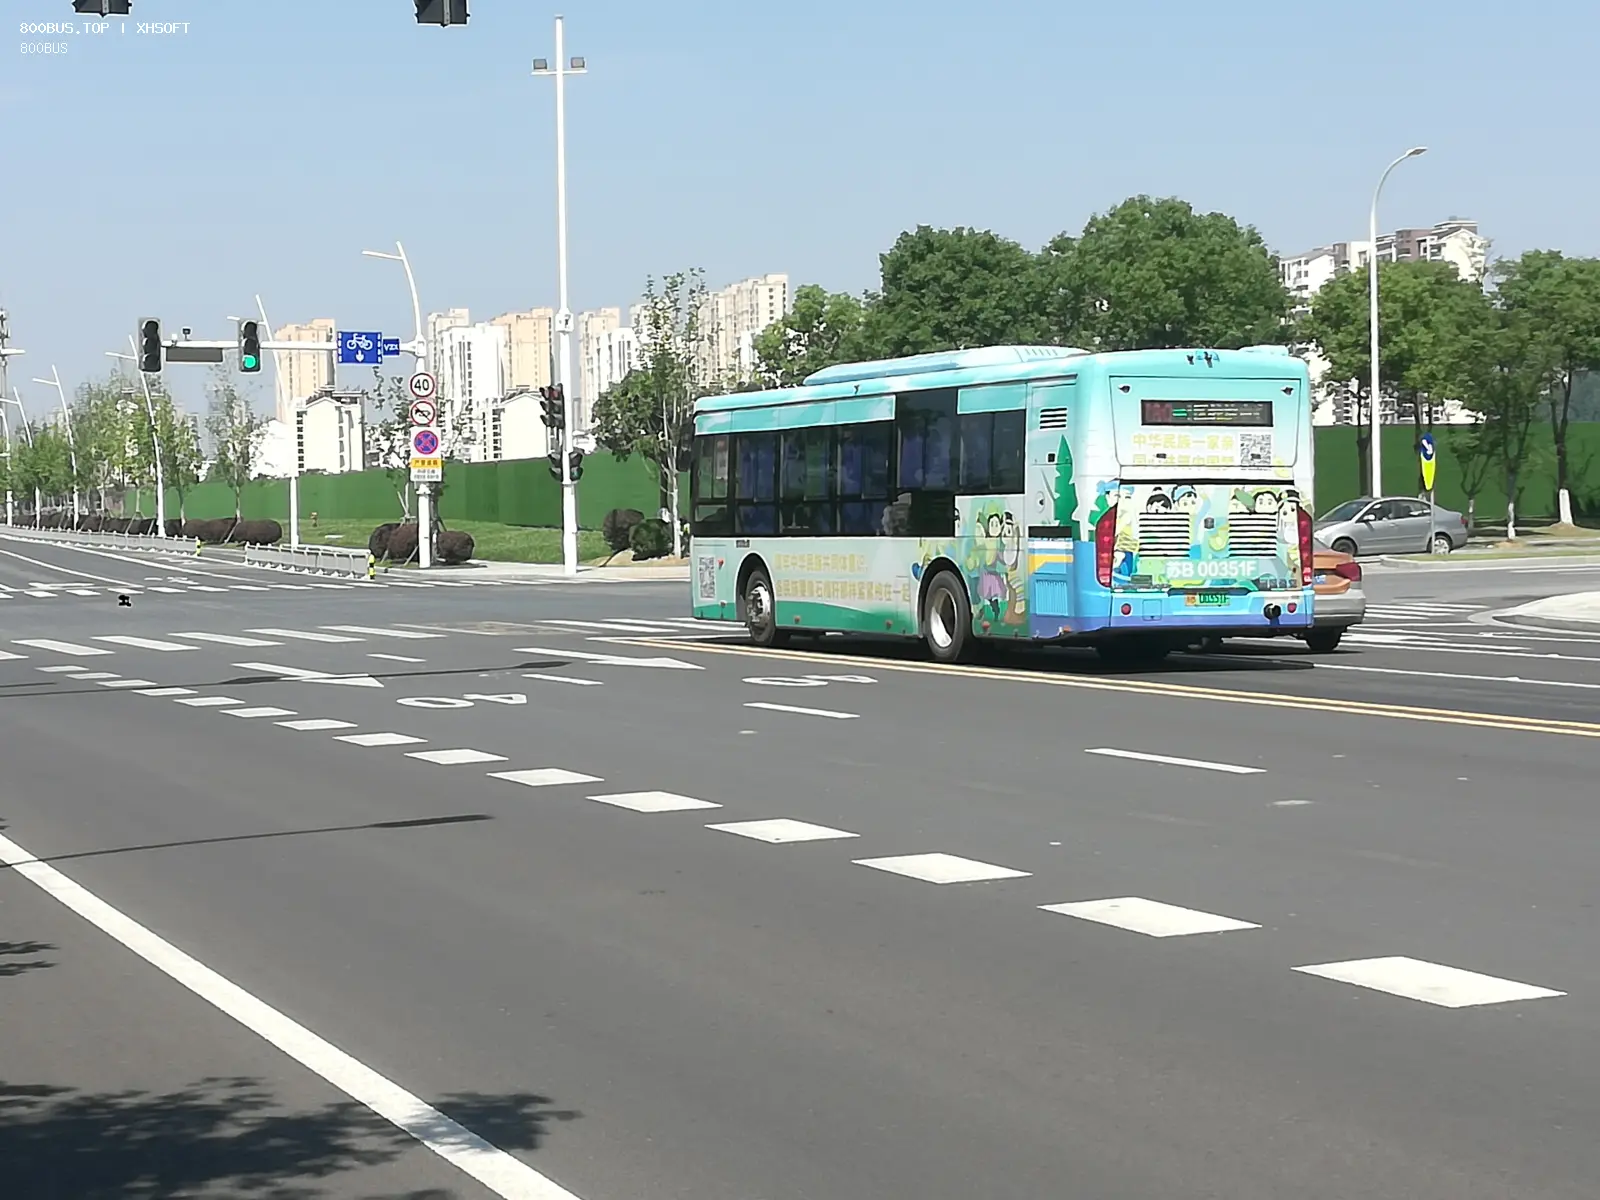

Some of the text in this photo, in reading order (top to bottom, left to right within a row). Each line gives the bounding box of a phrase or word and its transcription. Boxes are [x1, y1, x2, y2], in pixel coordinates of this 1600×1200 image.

[414, 378, 430, 392] 40
[1133, 433, 1235, 450] 中华民族一家亲
[1166, 560, 1258, 578] 苏B 00351F
